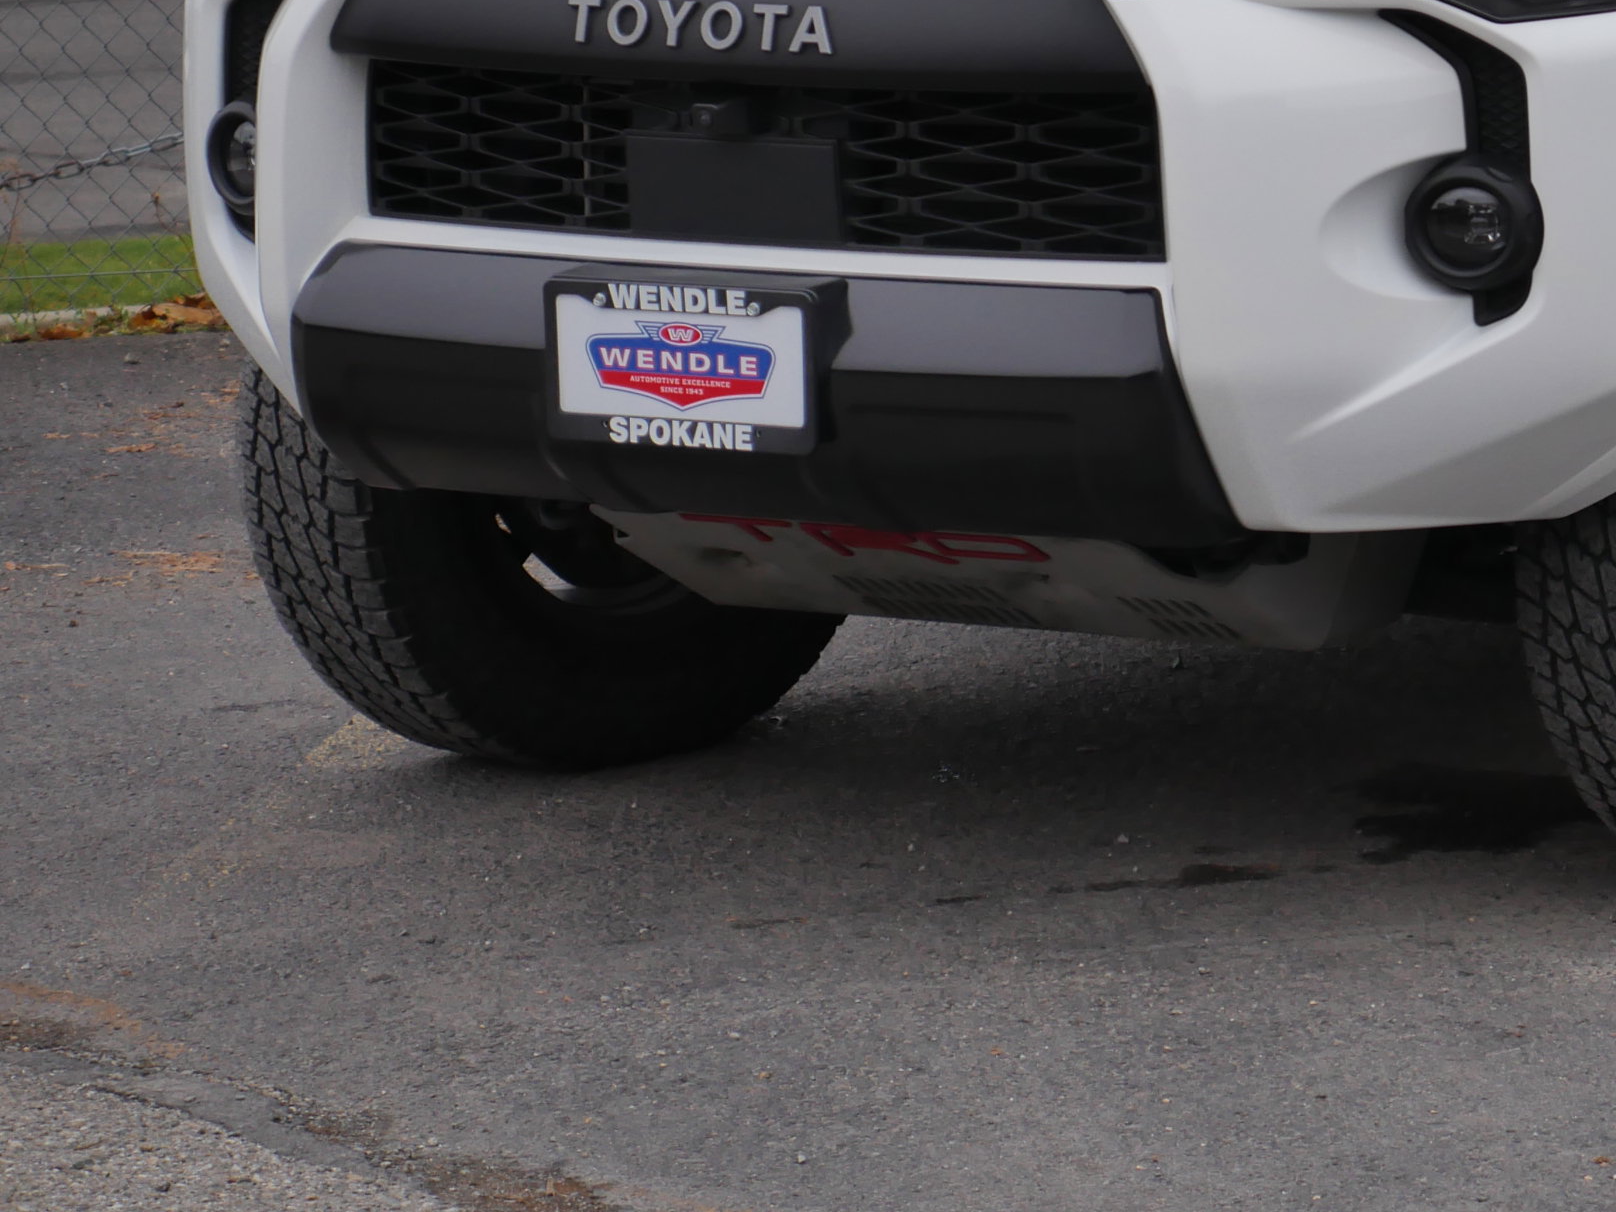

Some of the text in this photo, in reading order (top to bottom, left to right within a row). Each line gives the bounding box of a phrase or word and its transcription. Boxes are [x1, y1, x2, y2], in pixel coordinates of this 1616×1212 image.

[608, 284, 747, 316] WENDLE
[599, 347, 758, 376] WENDLE
[629, 375, 731, 388] AUTOMOTIVE EXCELLENCE
[660, 386, 684, 394] SINCE
[609, 416, 753, 451] SPOKANE
